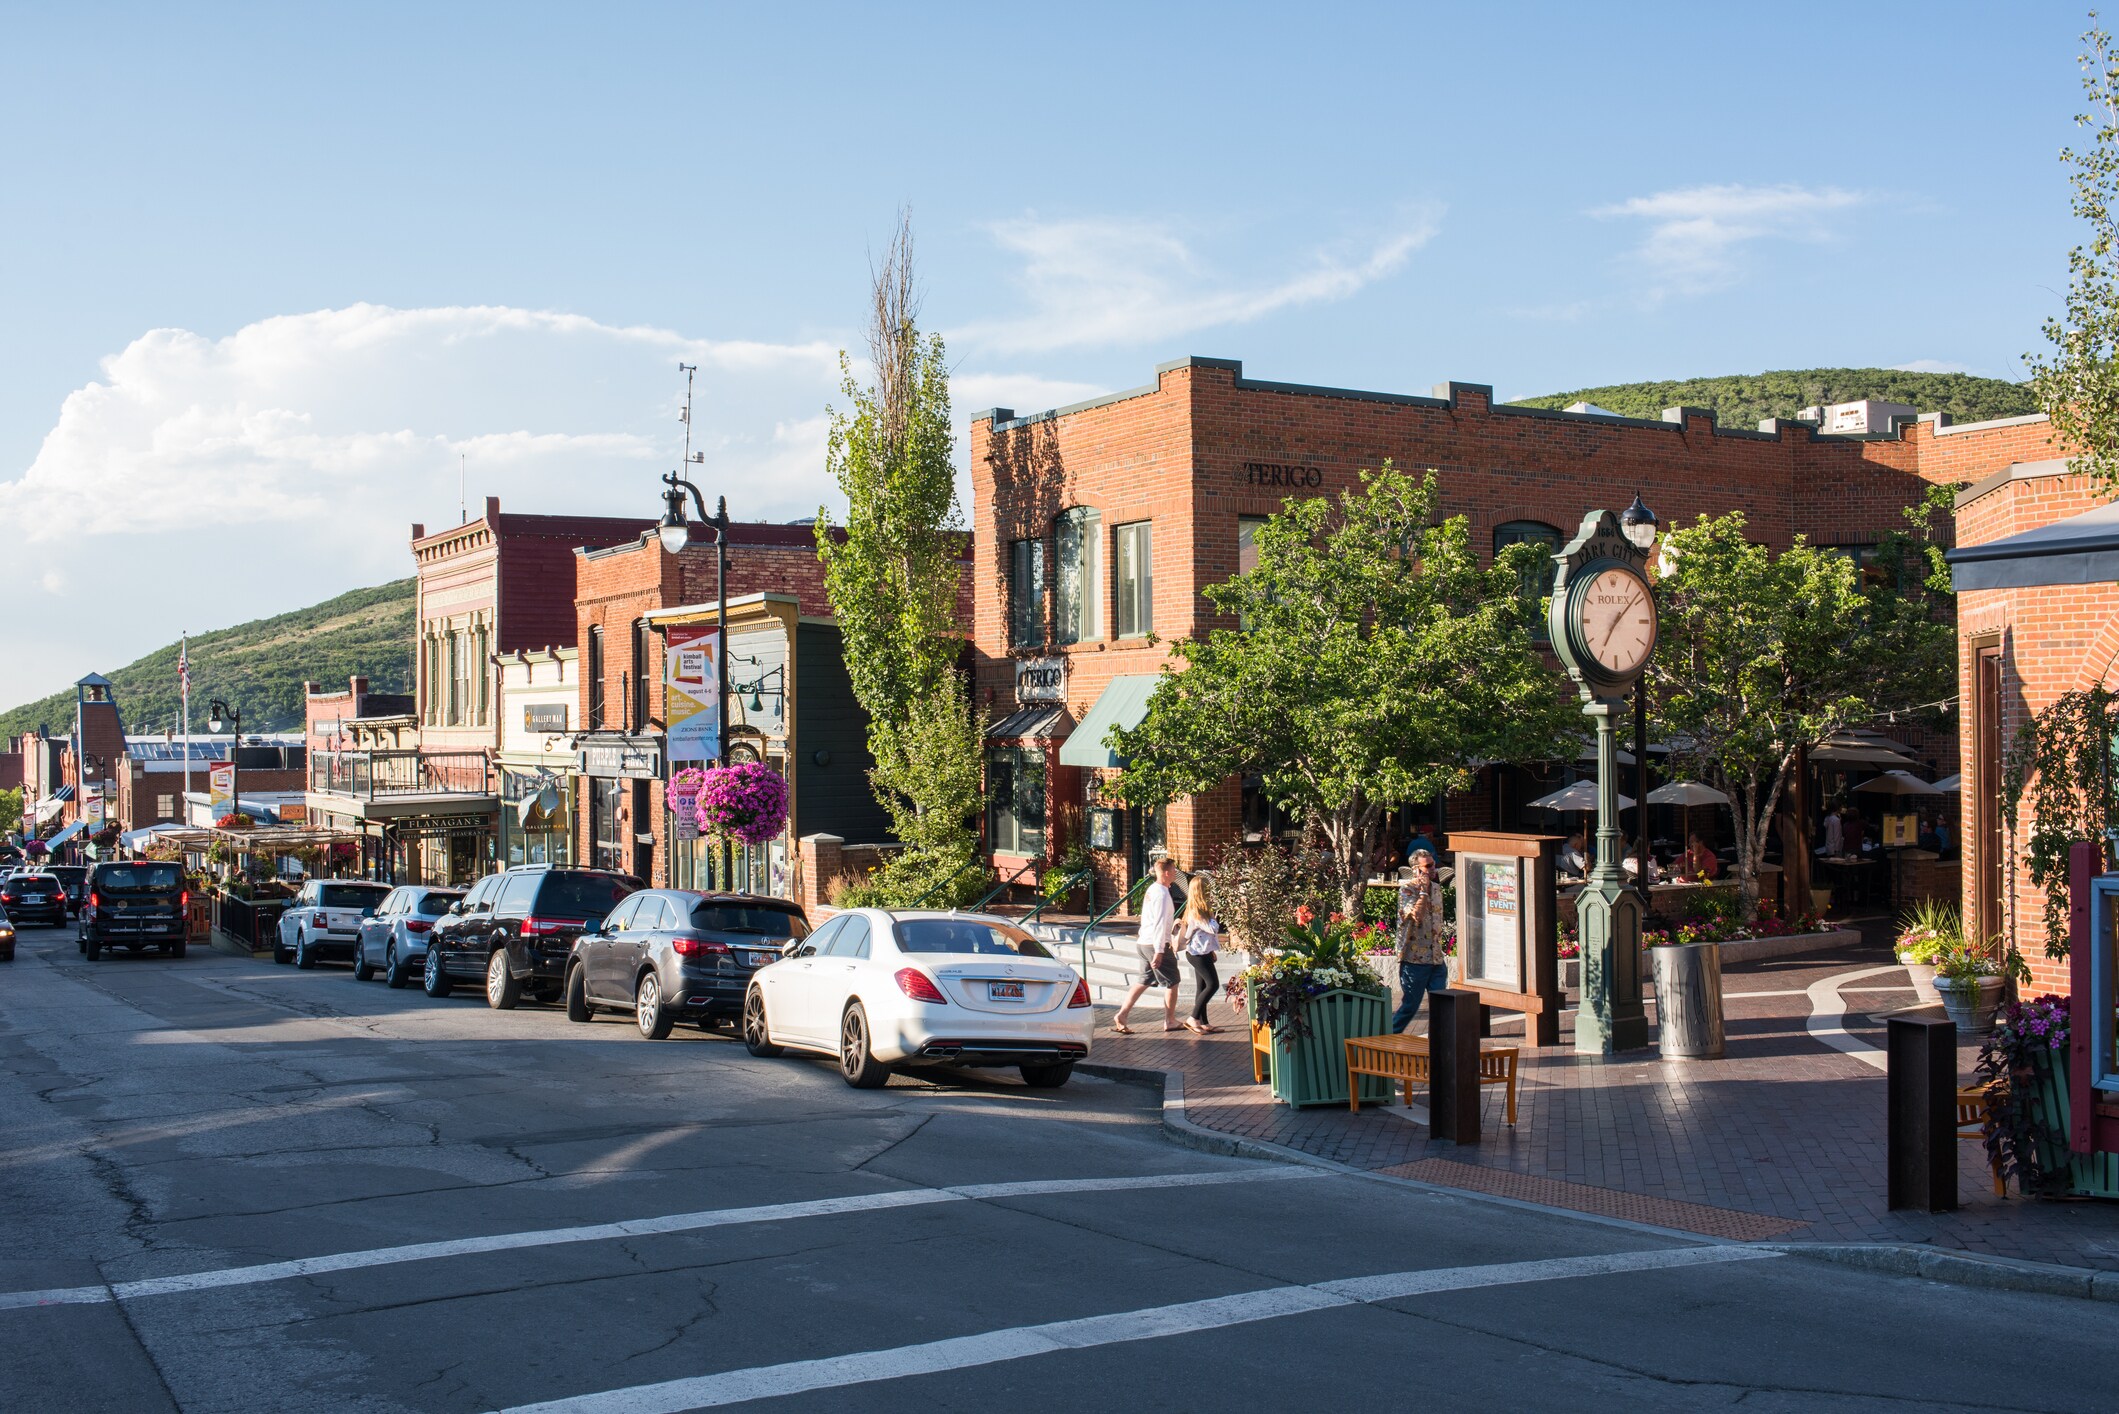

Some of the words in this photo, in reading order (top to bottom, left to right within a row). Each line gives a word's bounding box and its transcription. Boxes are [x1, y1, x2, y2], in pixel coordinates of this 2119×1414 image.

[1244, 461, 1322, 488] TERIGO
[1578, 543, 1606, 563] PARK
[1612, 544, 1636, 562] CITY
[1598, 595, 1630, 605] ROLEX
[1026, 666, 1062, 688] TERIGO
[592, 747, 617, 766] PURPLE
[409, 817, 481, 828] FLANAGAN'S
